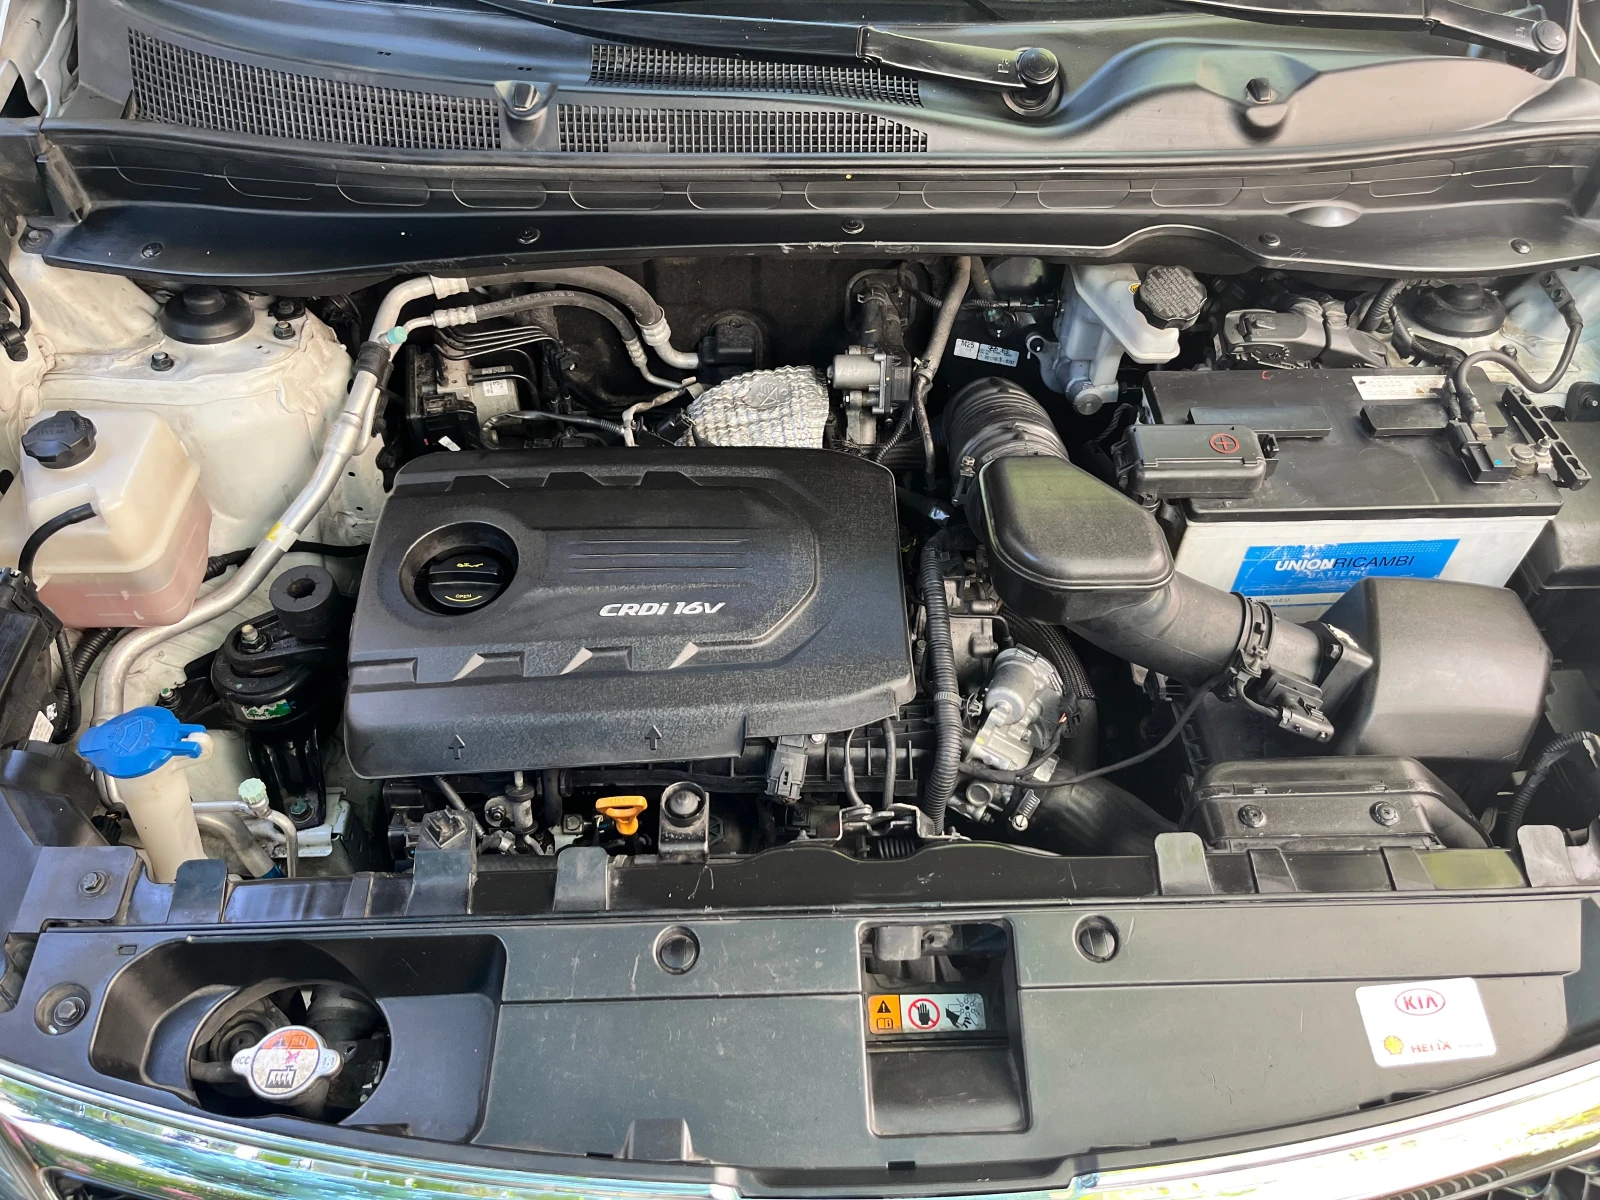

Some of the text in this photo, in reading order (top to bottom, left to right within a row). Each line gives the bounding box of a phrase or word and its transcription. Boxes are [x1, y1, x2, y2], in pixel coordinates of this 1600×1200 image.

[598, 601, 726, 617] CRDi 16V
[1403, 995, 1438, 1010] KIA
